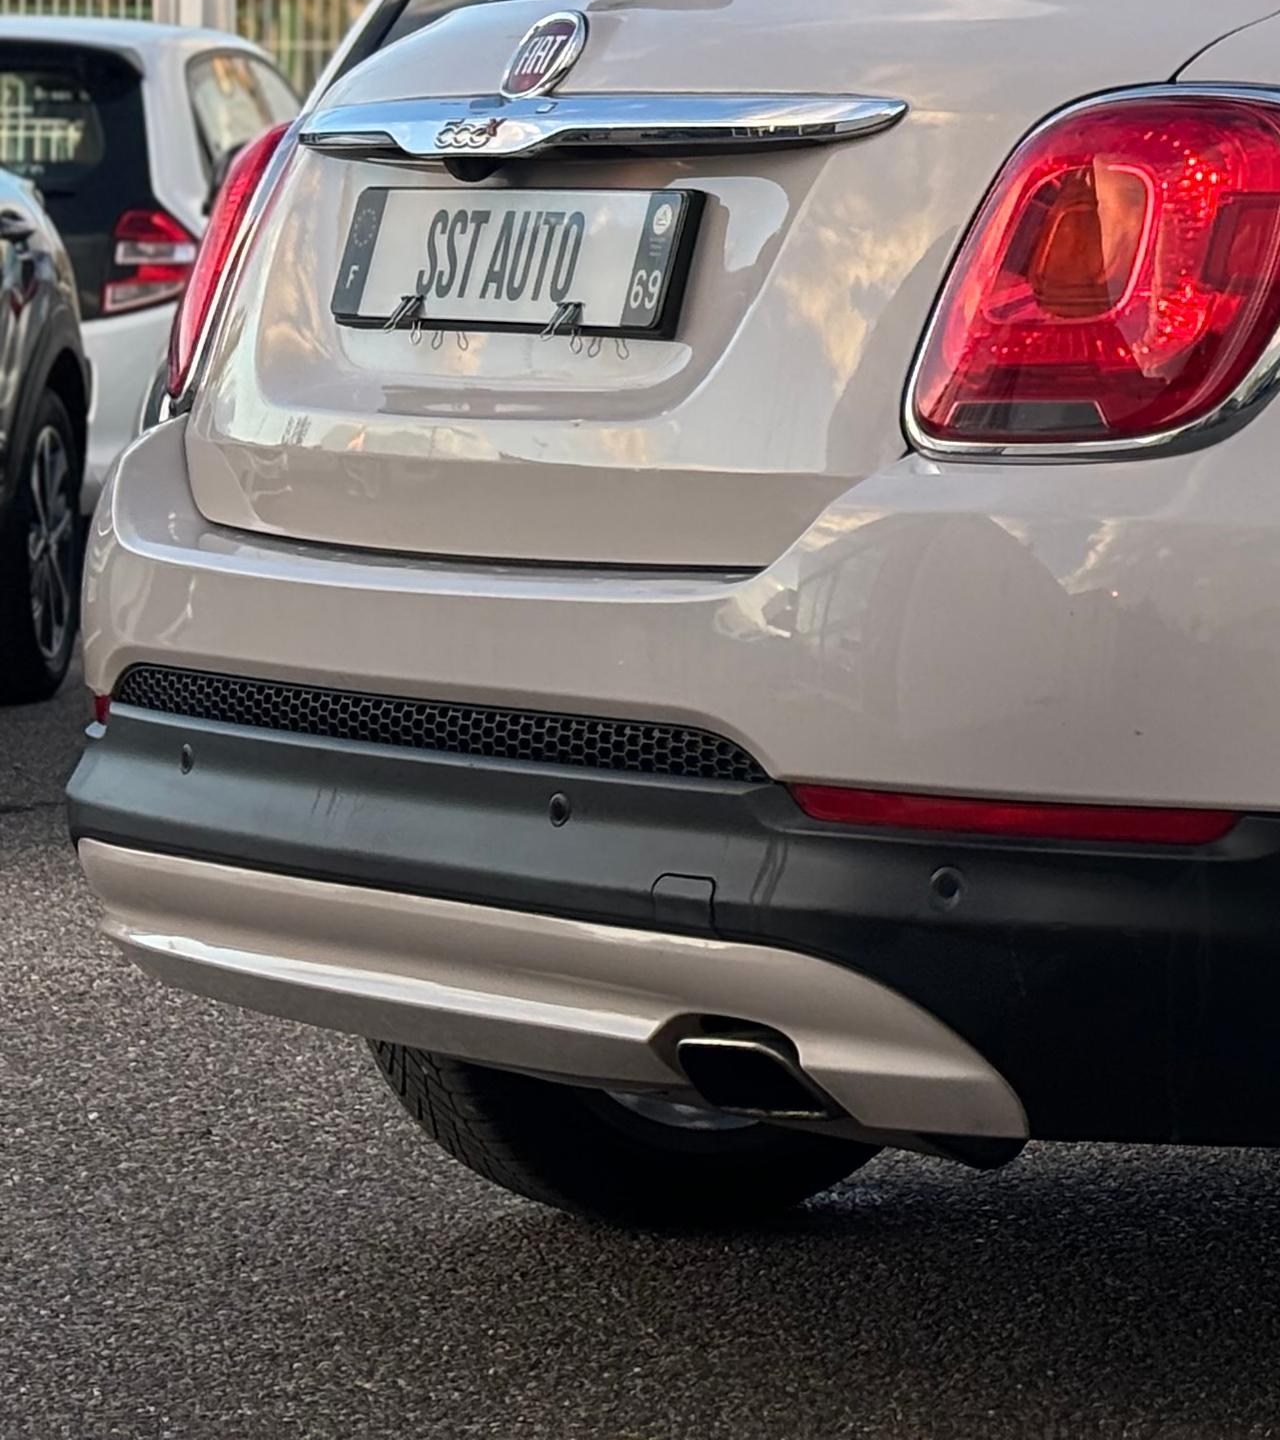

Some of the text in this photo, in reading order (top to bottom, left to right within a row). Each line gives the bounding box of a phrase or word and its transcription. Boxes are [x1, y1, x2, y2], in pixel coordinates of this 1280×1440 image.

[514, 34, 568, 76] FIAT
[415, 209, 585, 302] SST AUTO
[345, 264, 359, 289] F
[630, 269, 662, 309] 69
